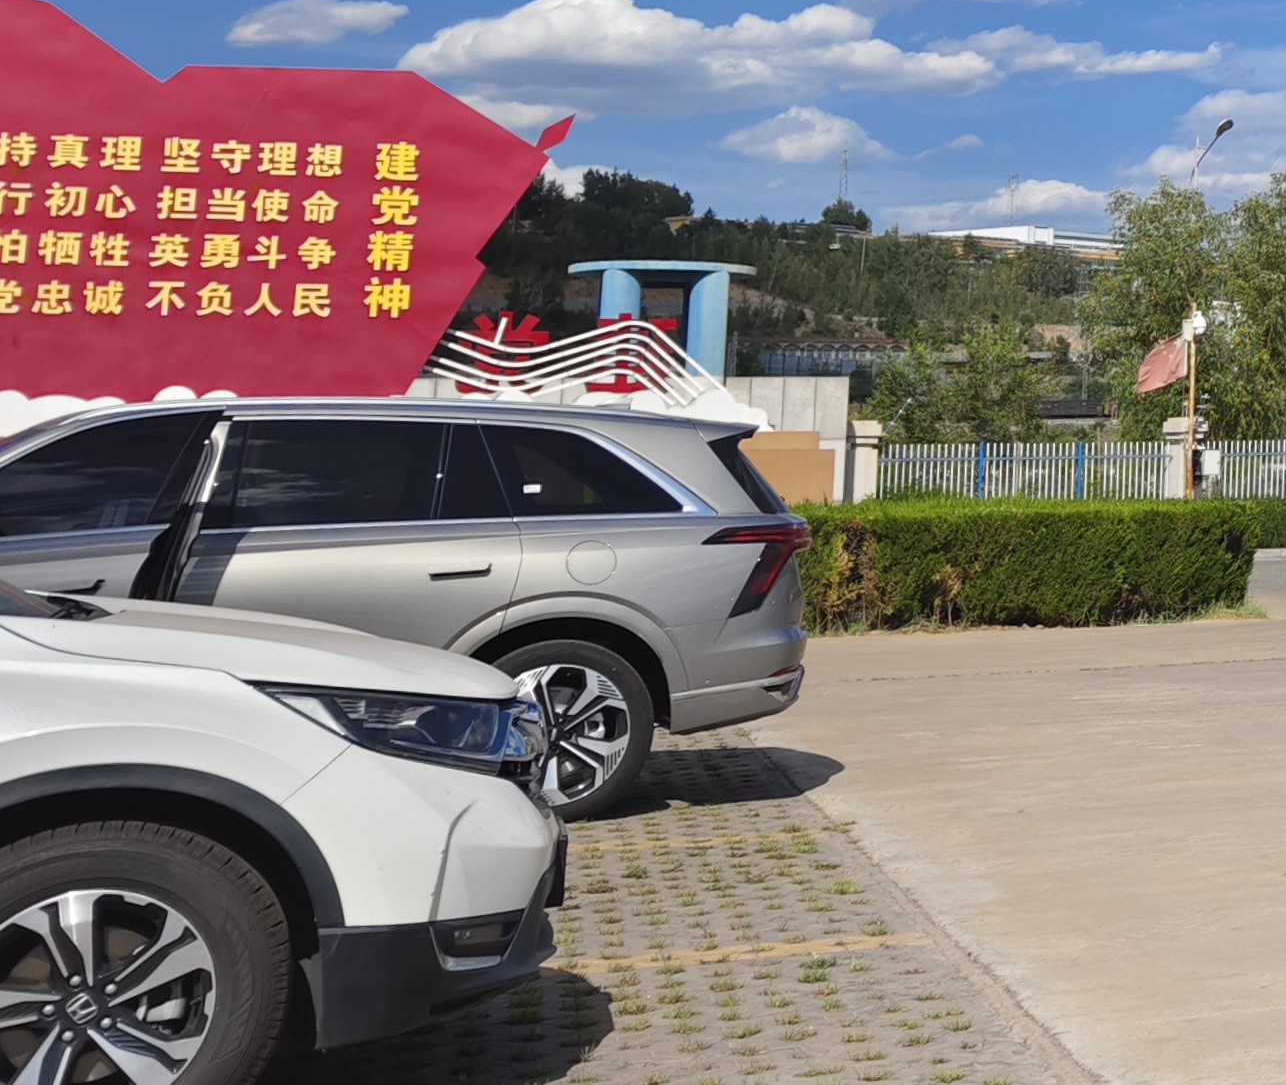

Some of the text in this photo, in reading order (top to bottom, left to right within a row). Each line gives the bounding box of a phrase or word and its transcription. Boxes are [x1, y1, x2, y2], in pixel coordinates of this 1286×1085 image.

[0, 132, 344, 178] 持真理 坚守理想
[156, 185, 340, 224] 担当使命
[362, 141, 421, 319] 建党精神
[148, 233, 337, 271] 英勇斗争
[145, 280, 332, 318] 不负人民
